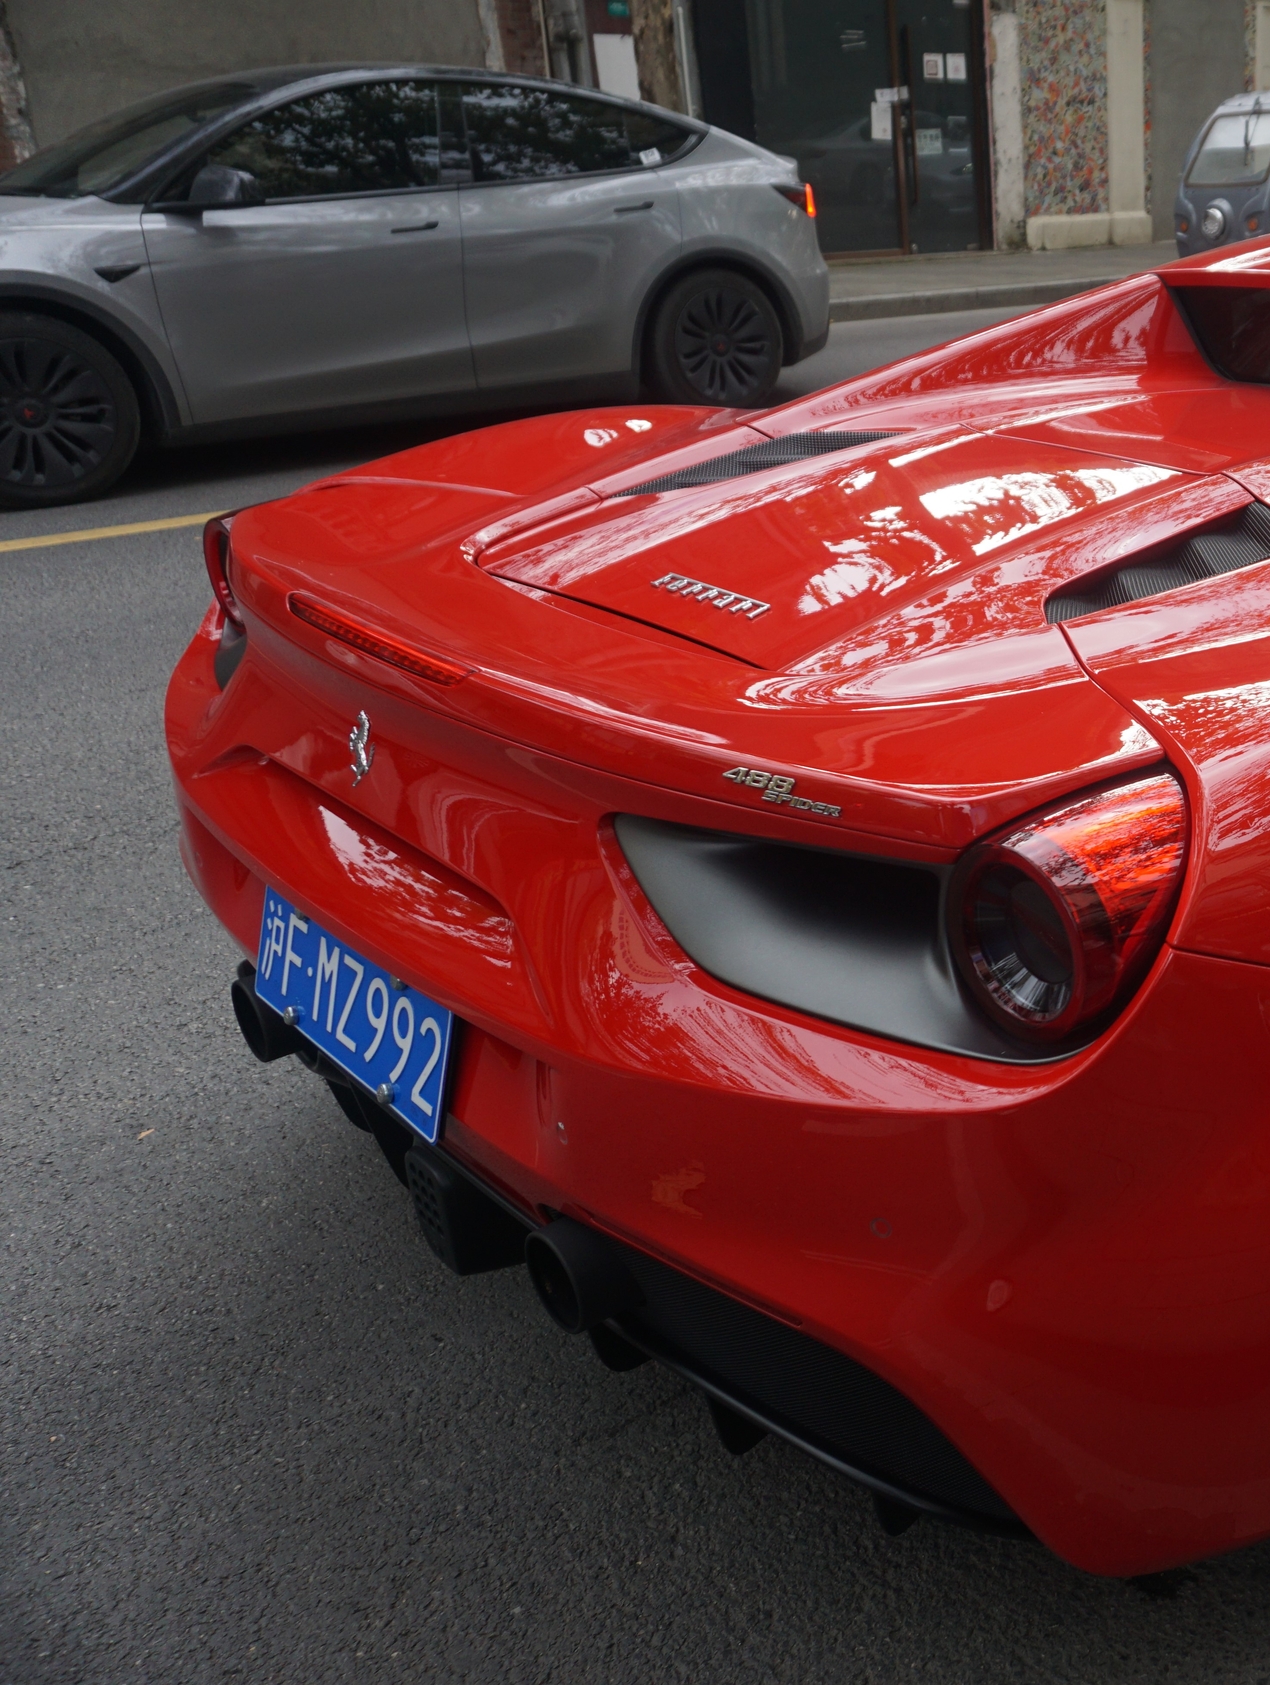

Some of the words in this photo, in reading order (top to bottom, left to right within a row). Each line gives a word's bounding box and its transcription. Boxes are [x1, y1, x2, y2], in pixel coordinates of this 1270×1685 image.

[722, 766, 796, 794] 488
[761, 789, 842, 817] SPIDER
[260, 899, 443, 1118] 沪F·MZ992
